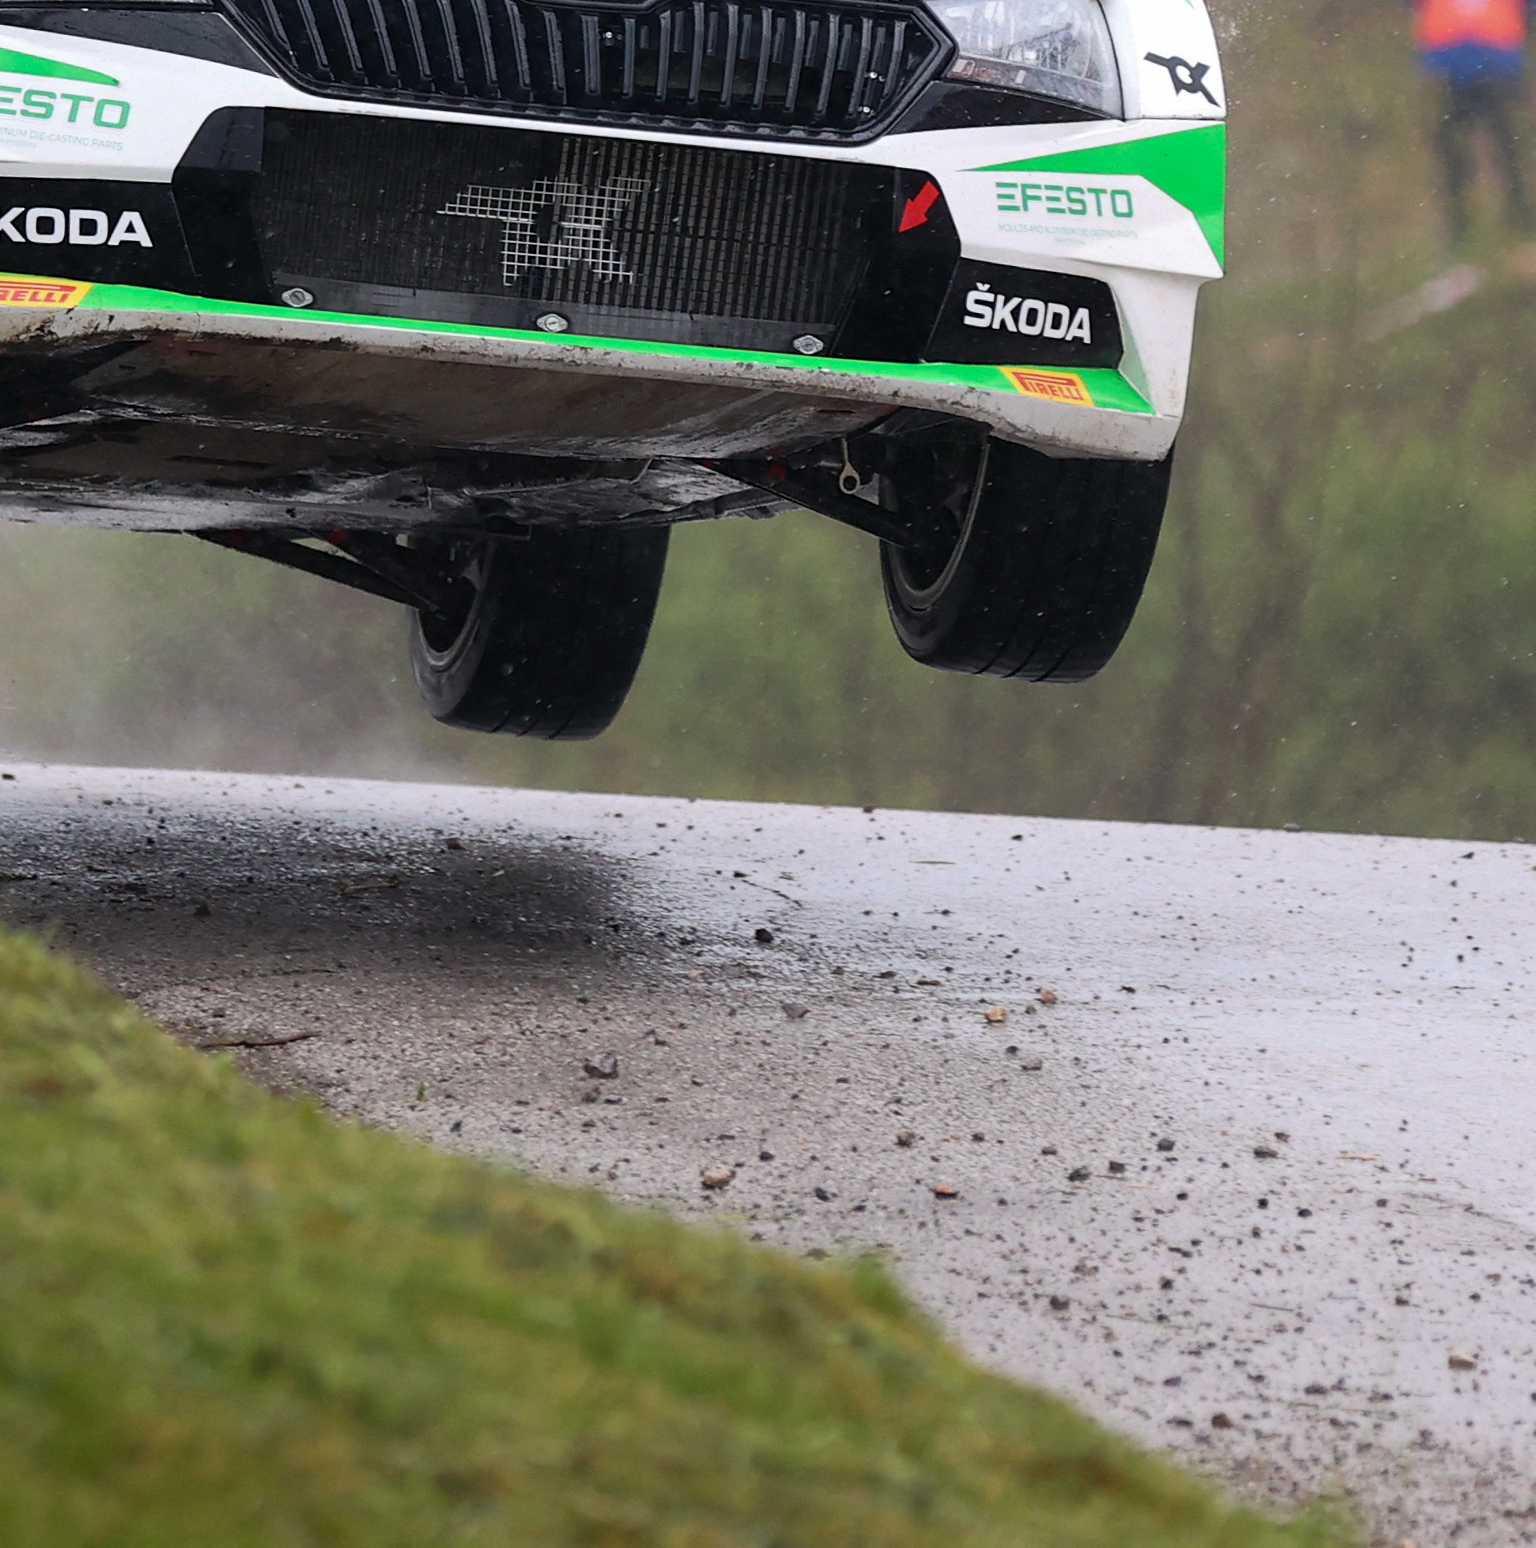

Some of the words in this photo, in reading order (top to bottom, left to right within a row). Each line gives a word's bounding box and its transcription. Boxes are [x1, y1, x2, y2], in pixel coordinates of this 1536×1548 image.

[91, 138, 123, 151] PARTS
[995, 182, 1133, 218] EFESTO
[963, 282, 1092, 344] ŠKODA
[1012, 371, 1084, 401] PIRELLI
